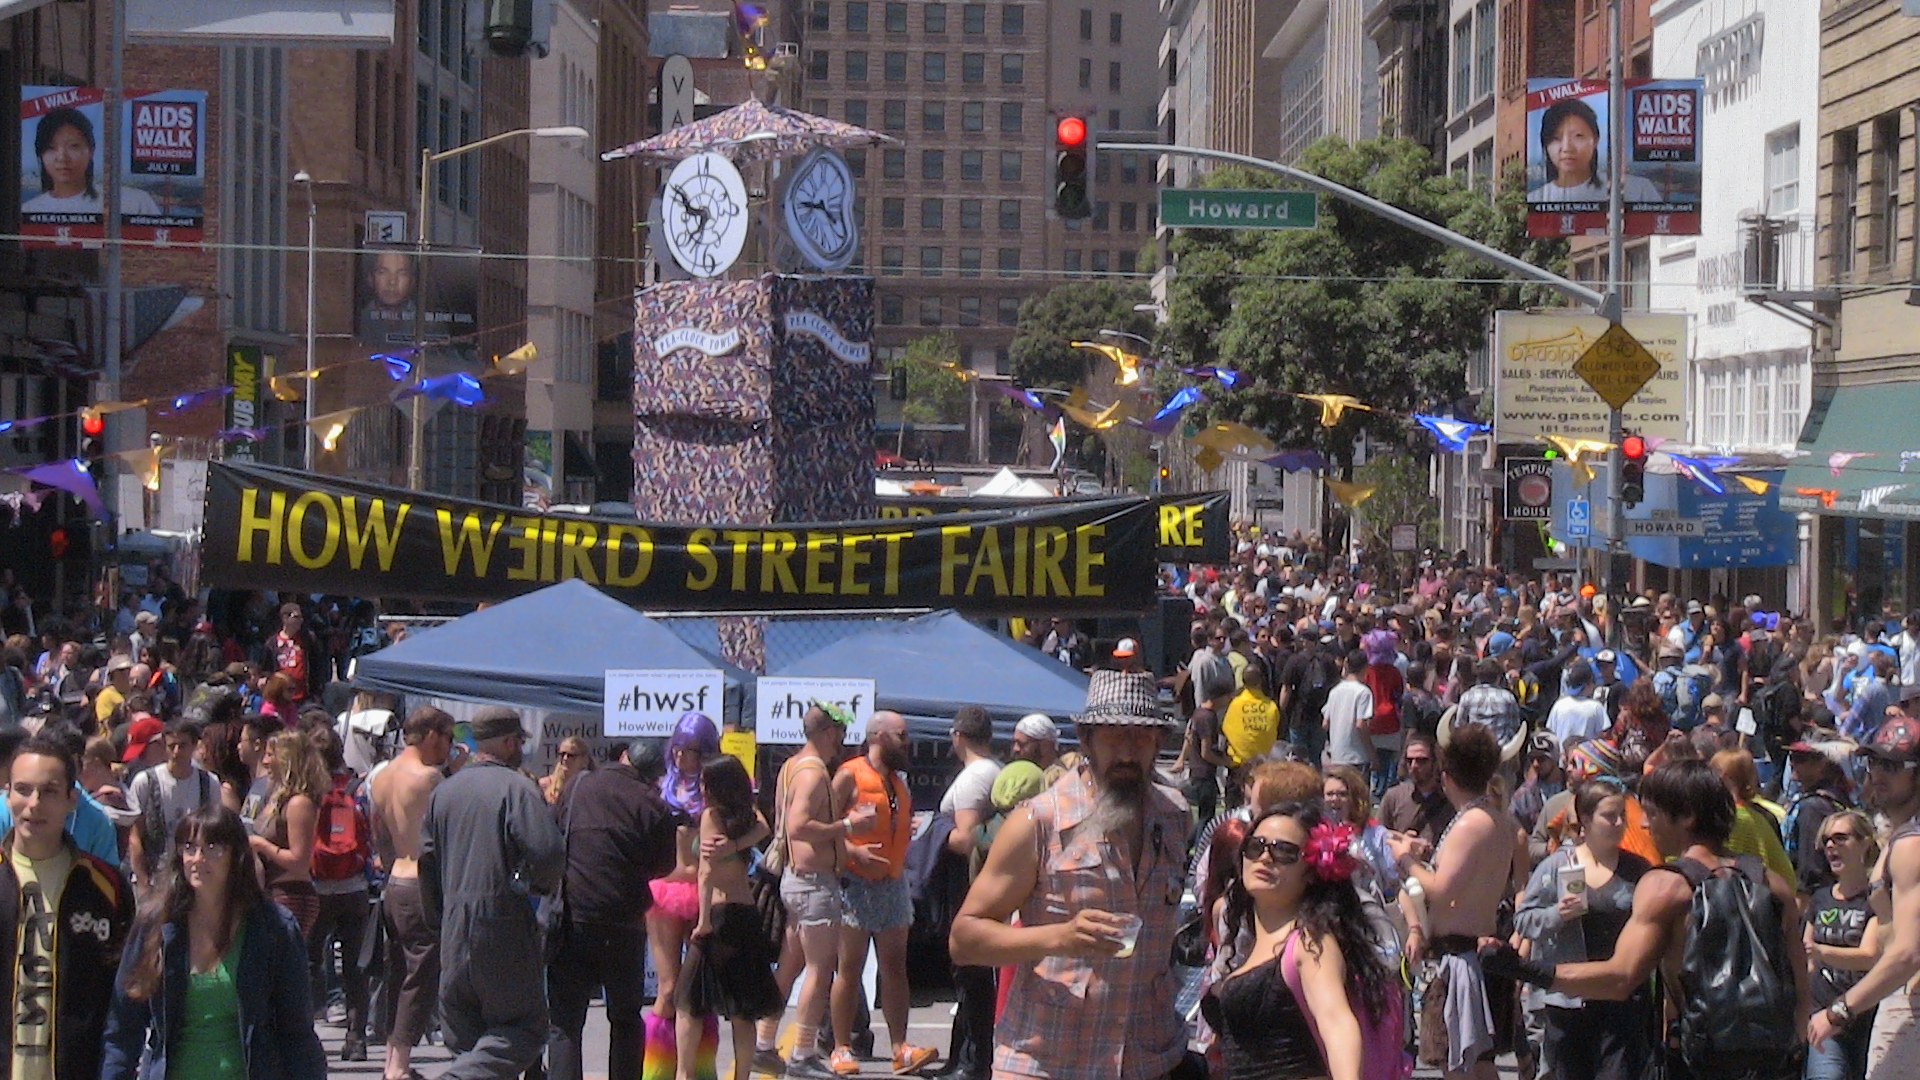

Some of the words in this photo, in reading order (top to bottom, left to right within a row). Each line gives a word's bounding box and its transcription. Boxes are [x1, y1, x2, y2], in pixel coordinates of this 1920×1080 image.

[1539, 92, 1546, 103] I
[1637, 93, 1692, 116] AIDS
[137, 105, 193, 128] AIDS
[1637, 116, 1692, 135] WALK
[136, 129, 192, 148] WALK
[1637, 136, 1652, 145] SAN
[1648, 150, 1669, 159] JULY
[147, 162, 169, 172] JULY
[1188, 198, 1289, 219] Howard
[1502, 369, 1532, 379] SALES
[1540, 425, 1558, 433] 181
[1563, 425, 1604, 433] Second
[1508, 463, 1553, 480] TEMPUR
[1635, 522, 1695, 533] HOWARD
[237, 488, 411, 573] HOW
[684, 528, 914, 595] STREET
[939, 524, 1106, 598] FAIRE
[618, 684, 710, 712] #hwsf
[543, 723, 597, 738] World
[618, 720, 676, 732] HowWeir
